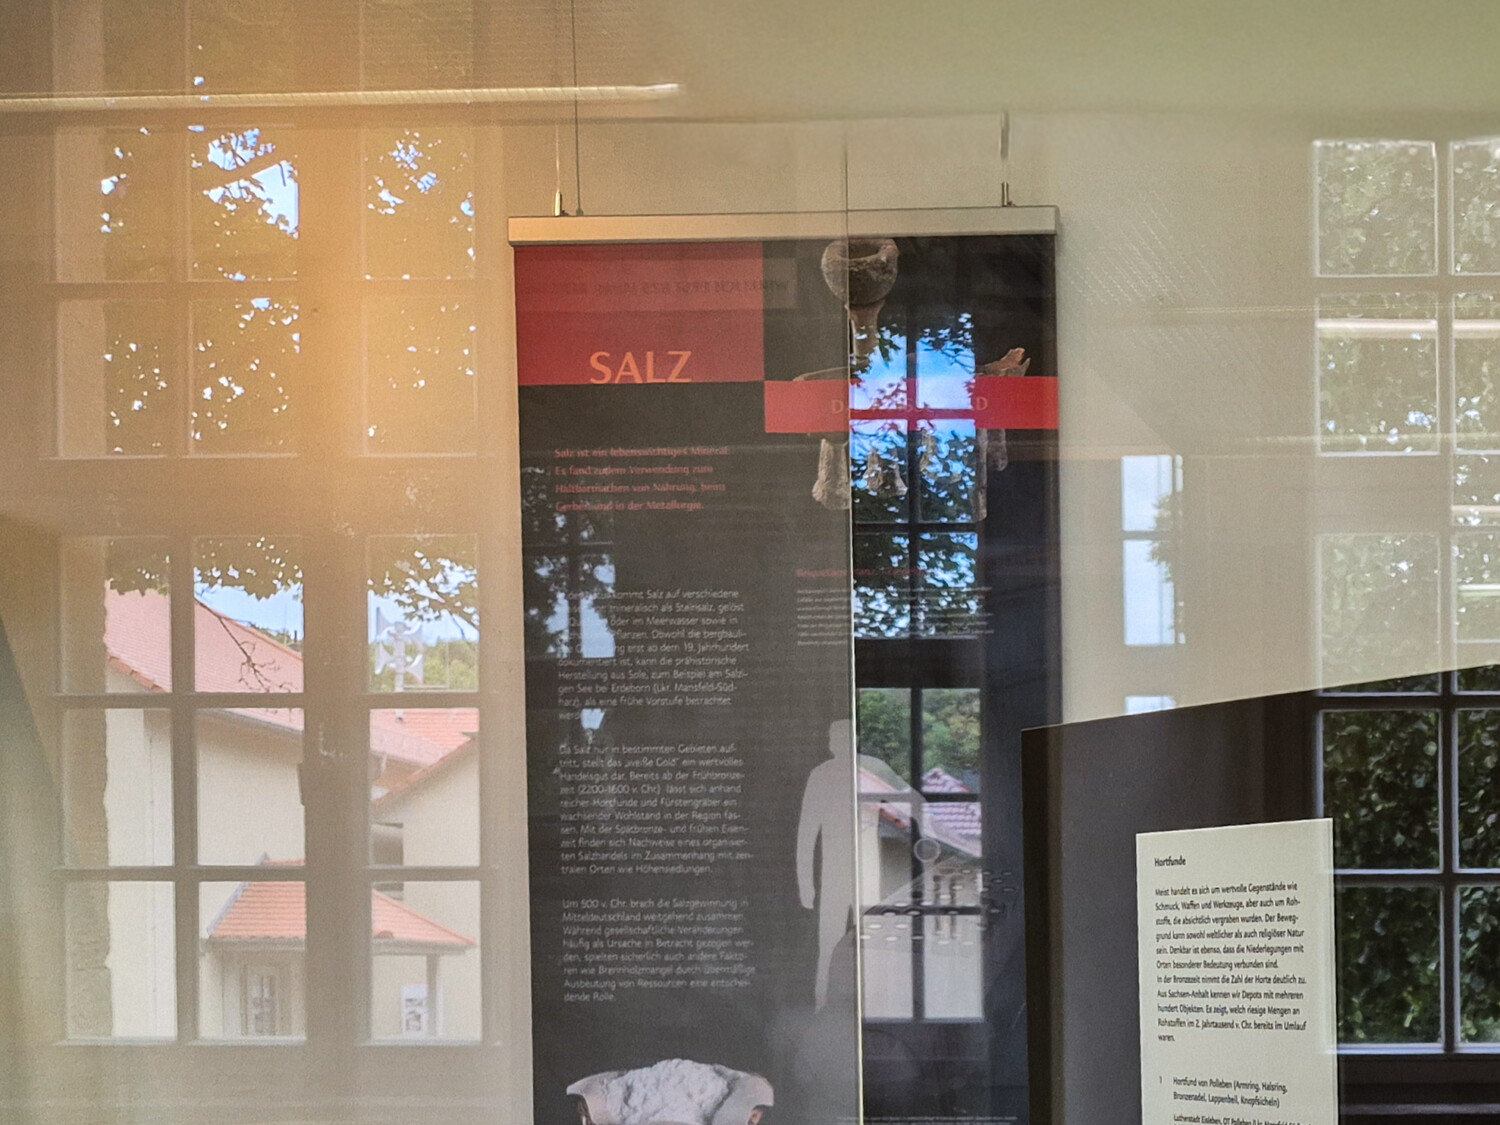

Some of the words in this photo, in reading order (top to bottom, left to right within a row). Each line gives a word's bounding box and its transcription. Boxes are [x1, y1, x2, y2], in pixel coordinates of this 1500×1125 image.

[589, 350, 693, 385] SALZ
[1154, 855, 1186, 866] Hortfunde
[1155, 931, 1172, 943] grund
[1172, 931, 1185, 940] kann
[1186, 930, 1206, 939] sowohl
[1206, 929, 1234, 939] weltlicher
[1234, 928, 1243, 939] als
[1243, 928, 1258, 938] auch
[1258, 928, 1286, 940] religiöser
[1286, 928, 1305, 937] Natur
[1169, 945, 1192, 954] Denkbar
[1192, 946, 1200, 954] ist
[1200, 945, 1222, 954] ebenso,
[1222, 944, 1235, 954] dass
[1235, 943, 1245, 954] die
[1245, 944, 1292, 956] Niederlegungen
[1292, 944, 1304, 953] mit
[1156, 960, 1172, 969] Orten
[1172, 960, 1202, 969] besonderer
[1202, 959, 1233, 971] Bedeutung
[1233, 958, 1264, 969] verbunden
[1264, 959, 1279, 969] sind.
[1157, 989, 1167, 998] Aus
[1167, 989, 1209, 998] Sachsen-Anhalt
[1209, 990, 1231, 999] kennen
[1231, 990, 1241, 998] wir
[1241, 989, 1262, 1001] Depots
[1263, 990, 1274, 999] mit
[1274, 990, 1304, 1000] mehreren
[1158, 1075, 1163, 1084] 1
[1172, 1076, 1197, 1086] Hortfund
[1208, 1078, 1232, 1088] Polleben
[1233, 1080, 1261, 1093] (Armring,
[1261, 1081, 1288, 1094] Halsring,
[1172, 1091, 1207, 1102] Bronzenadel,
[1207, 1094, 1239, 1104] Lappenbeil,
[1240, 1095, 1280, 1108] Knopfsicheln)
